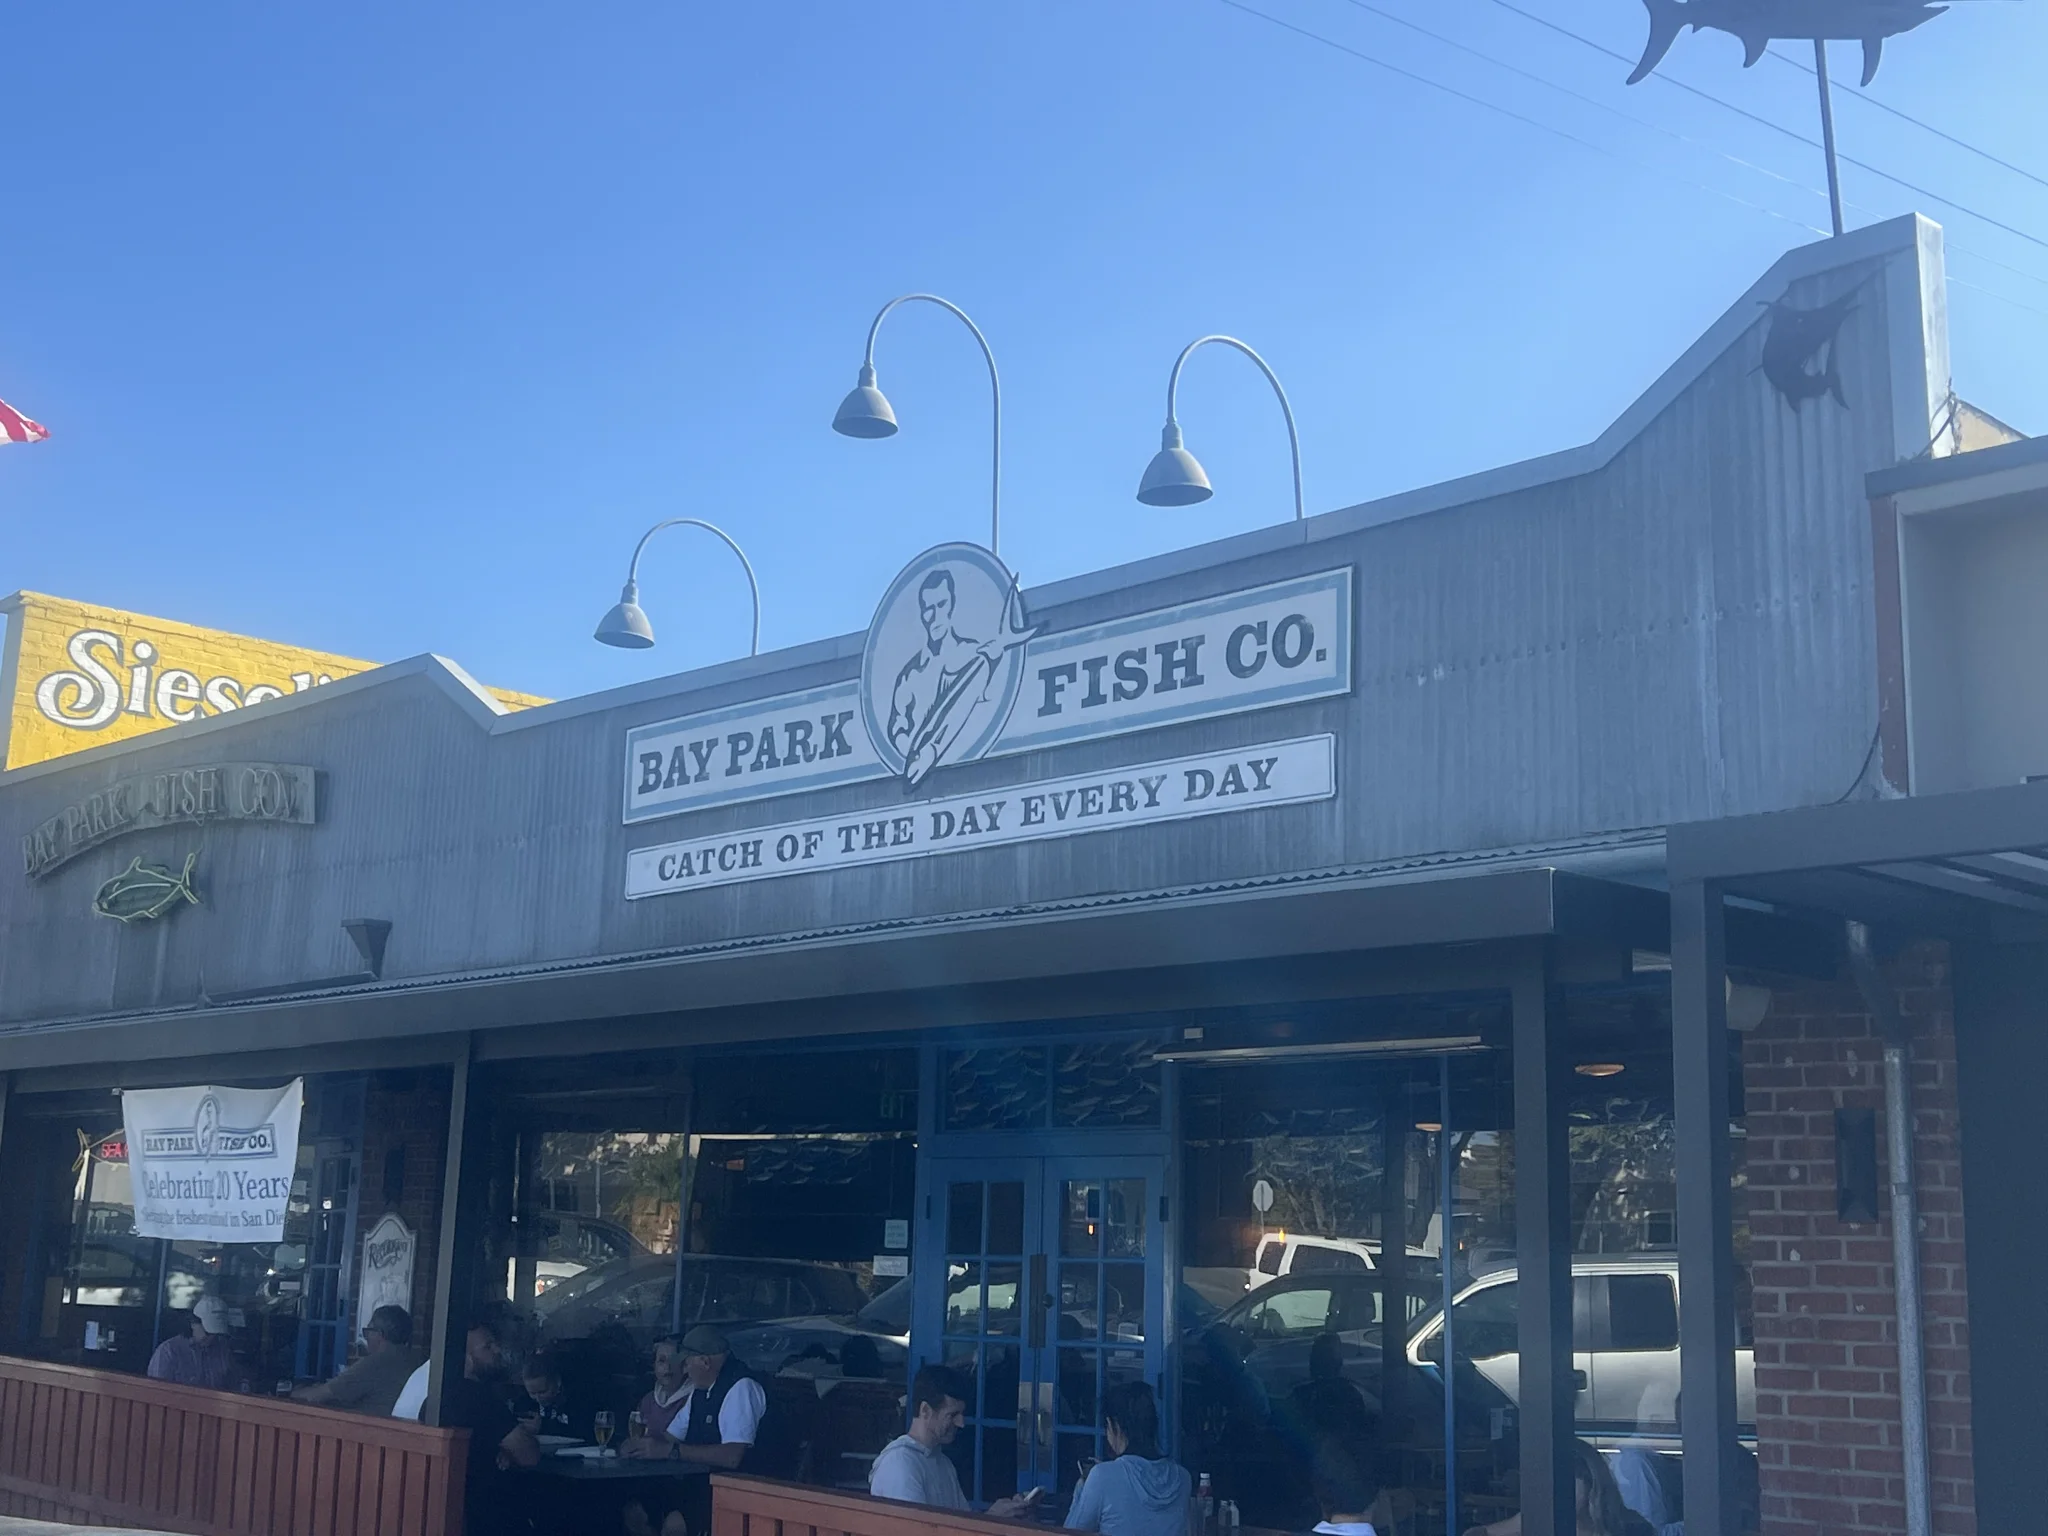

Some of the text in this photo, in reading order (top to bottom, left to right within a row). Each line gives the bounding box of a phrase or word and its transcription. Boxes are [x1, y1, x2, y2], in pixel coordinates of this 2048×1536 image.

[638, 613, 1328, 795] BAY PARK FISH CO.
[21, 817, 62, 875] BAY
[63, 784, 132, 846] PARK
[153, 767, 220, 818] FISH
[658, 757, 1279, 881] CATCH OF THE DAY EVERY DAY
[248, 1134, 271, 1149] CO.
[232, 1170, 289, 1200] Years
[241, 1210, 263, 1226] San
